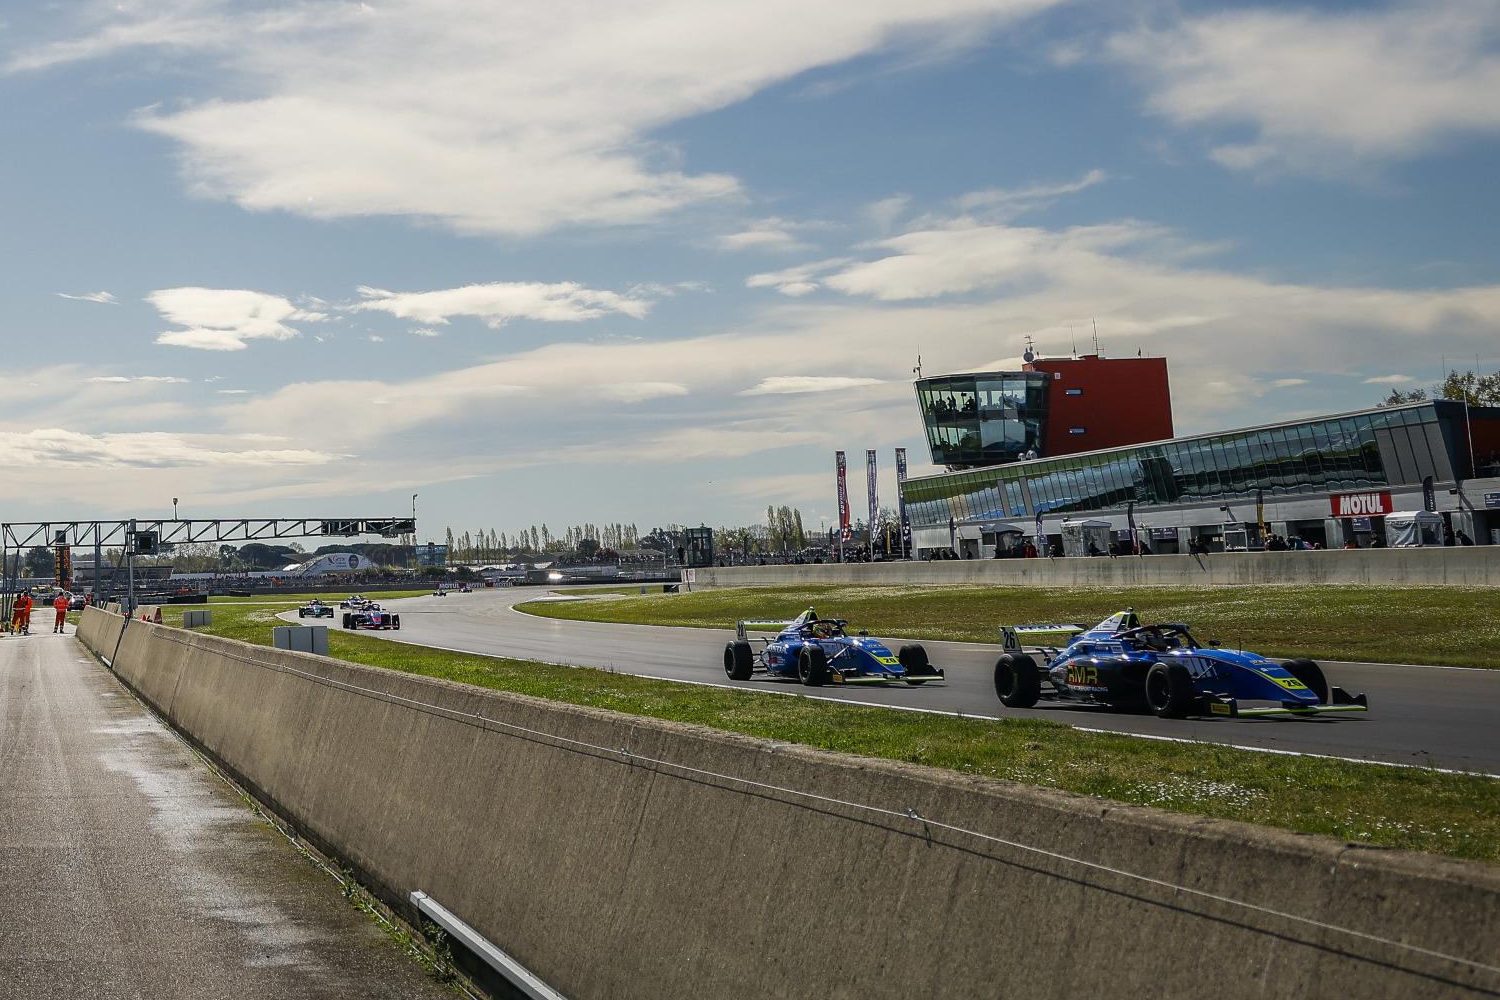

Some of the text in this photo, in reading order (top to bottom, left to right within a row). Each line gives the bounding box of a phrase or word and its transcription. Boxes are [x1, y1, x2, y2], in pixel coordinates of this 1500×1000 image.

[1340, 493, 1384, 515] MOTUL
[1004, 631, 1016, 649] 26
[1068, 665, 1098, 685] RMR
[1282, 679, 1303, 687] 26
